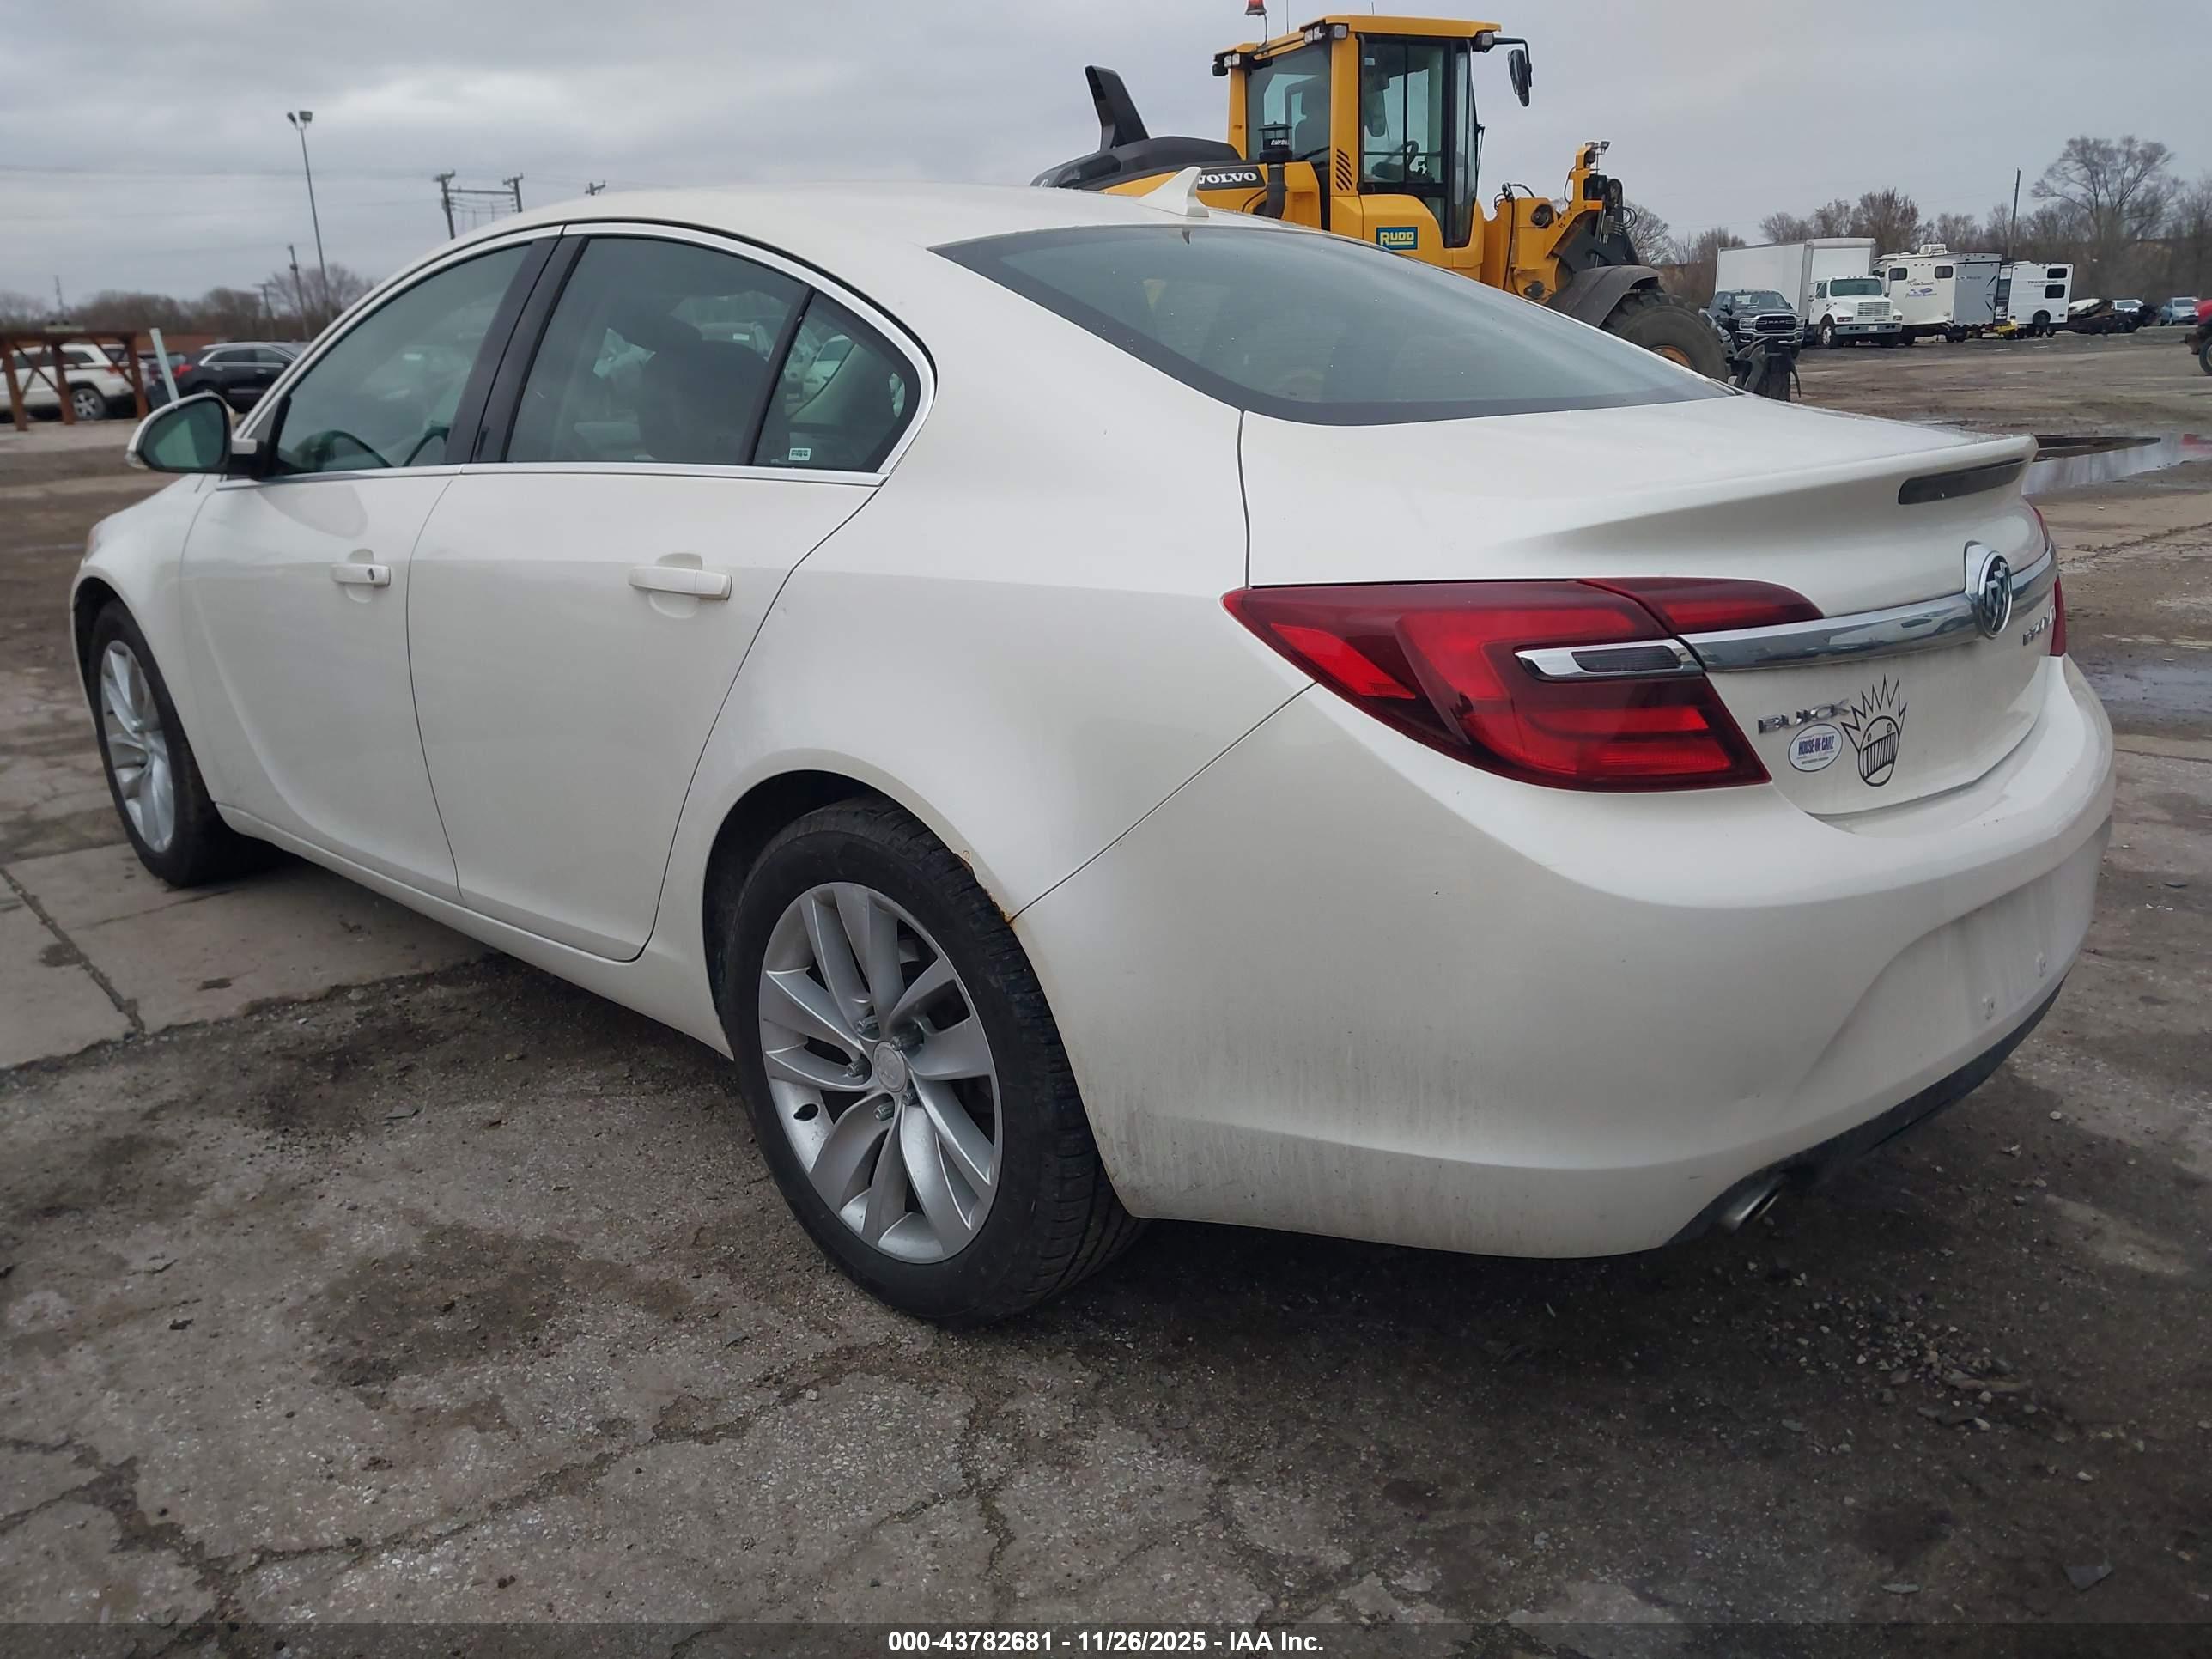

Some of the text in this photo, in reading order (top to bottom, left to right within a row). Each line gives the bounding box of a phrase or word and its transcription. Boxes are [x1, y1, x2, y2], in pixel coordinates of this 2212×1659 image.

[1198, 172, 1257, 185] VOLVO
[1379, 231, 1415, 246] RUDD
[1758, 698, 1850, 734] BUICK
[1797, 738, 1814, 756] HOUSE
[1814, 737, 1821, 752] OF
